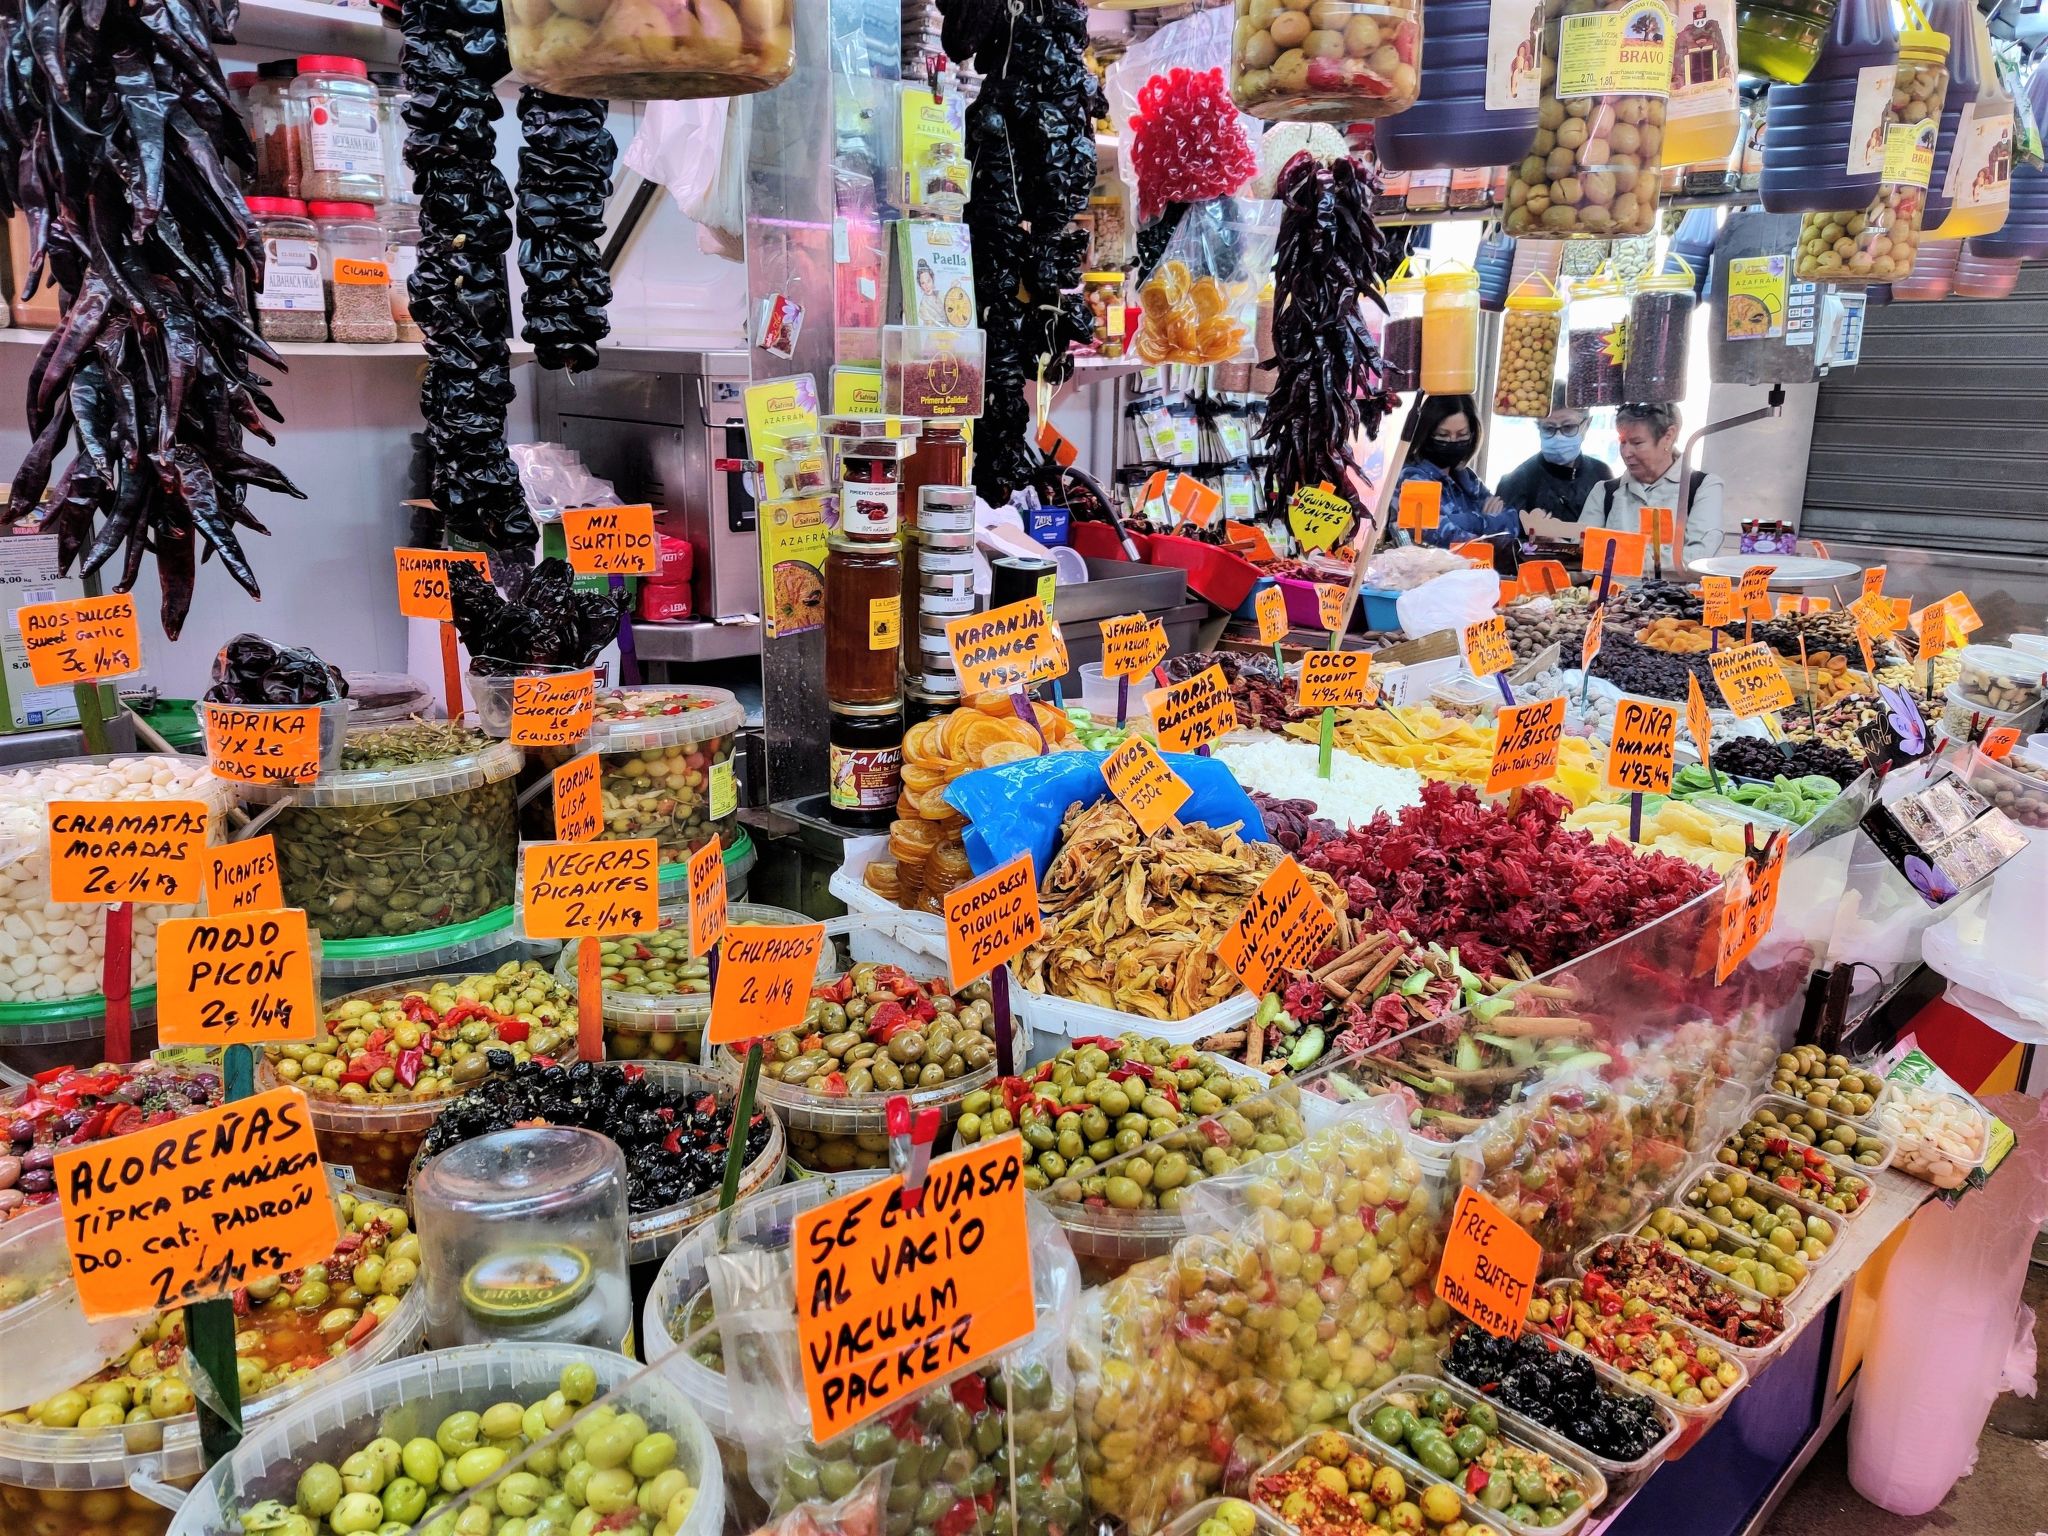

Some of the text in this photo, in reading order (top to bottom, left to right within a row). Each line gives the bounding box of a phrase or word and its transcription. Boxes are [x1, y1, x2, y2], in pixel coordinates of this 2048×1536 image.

[1619, 50, 1664, 64] BRAVO
[932, 252, 967, 266] Paella
[921, 394, 968, 404] Primera Calidad
[933, 405, 955, 414] España
[588, 515, 617, 530] MIX
[1295, 503, 1343, 524] PICANTES
[571, 534, 651, 550] SURTIDO
[671, 603, 687, 612] LEDA
[955, 604, 1044, 651] NARANJAS
[1106, 621, 1147, 638] JENGIBRE
[962, 634, 1039, 667] ORANGE
[1310, 655, 1356, 669] COCO
[1306, 672, 1357, 683] COCONUT
[1166, 673, 1215, 712] MORAS
[211, 710, 305, 734] PAPRIKA
[1158, 687, 1232, 733] BLACKBERRYS
[1515, 703, 1552, 732] FLOR
[1625, 705, 1672, 738] PIÑA
[1498, 723, 1562, 756] HIBISCO
[1616, 737, 1672, 758] ANANAS
[263, 762, 318, 779] DULCES
[558, 762, 594, 798] GORDAL
[561, 792, 586, 819] LISA
[52, 812, 207, 834] CALAMATAS
[64, 840, 188, 860] MORADAS
[213, 853, 275, 890] PICANTES
[541, 849, 651, 881] NEGRAS
[233, 883, 261, 908] HOT
[531, 876, 649, 905] PICANTES
[951, 868, 1027, 922] CORDOBESA
[959, 897, 1021, 941] PIQUILLO
[1240, 891, 1268, 939] MIX
[187, 922, 279, 953] MOJO
[71, 1103, 301, 1206] ALOREÑAS
[182, 1179, 215, 1204] DE
[810, 1155, 1020, 1264] SE ENVASA
[1456, 1197, 1498, 1246] FREE
[811, 1209, 985, 1317] AL VACÍO
[483, 1289, 553, 1300] BRAVO
[1474, 1254, 1528, 1306] BUFFET
[1443, 1275, 1518, 1340] PARA PROBAR
[809, 1277, 958, 1374] VACUUM
[822, 1314, 972, 1421] PACKER
